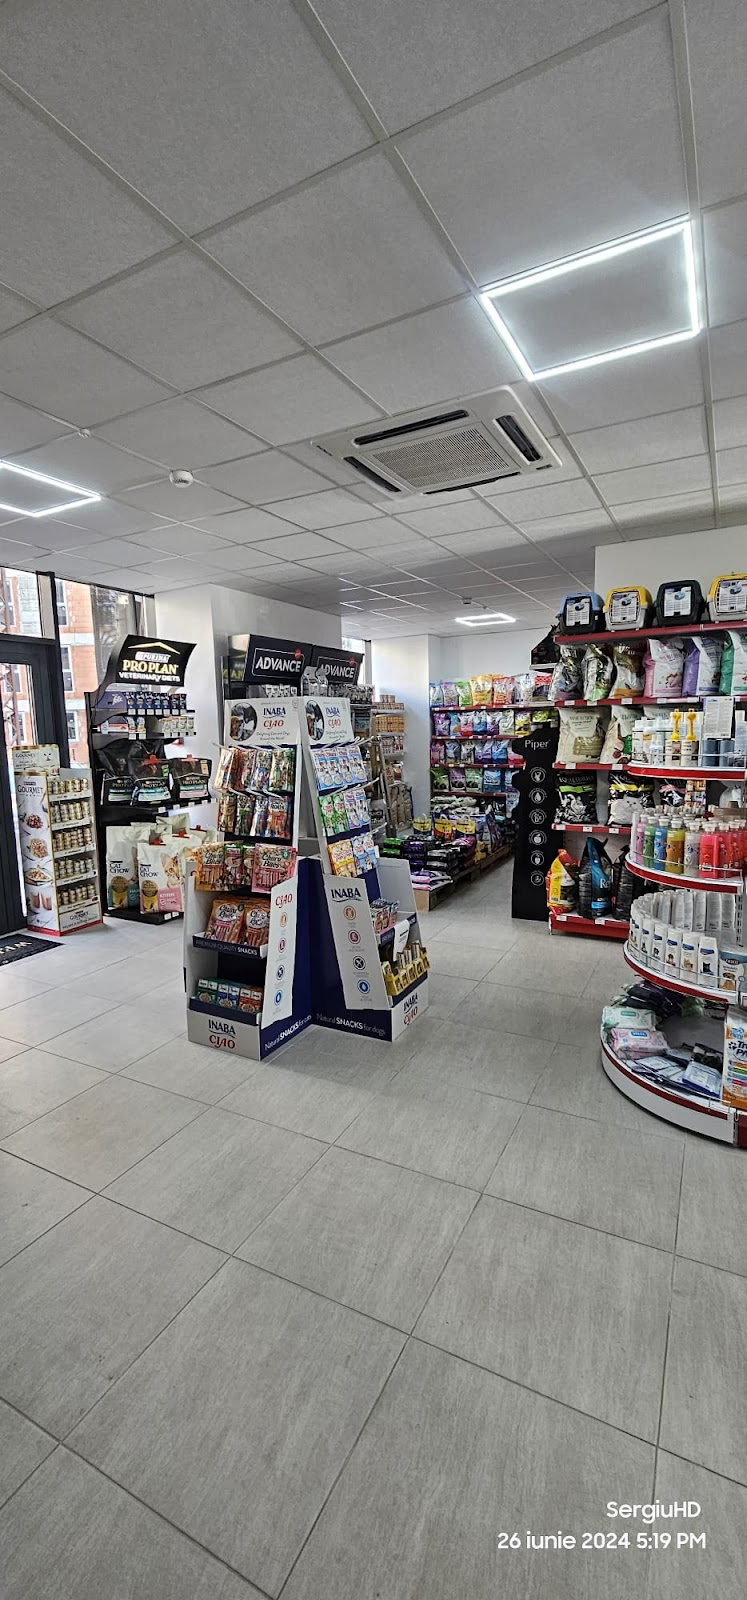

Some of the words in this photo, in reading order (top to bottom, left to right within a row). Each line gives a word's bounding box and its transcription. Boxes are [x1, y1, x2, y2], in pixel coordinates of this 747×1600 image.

[122, 660, 148, 672] PRO
[148, 662, 178, 674] PLAN
[256, 656, 302, 672] ADVANCE
[118, 672, 161, 682] VETERINARY
[263, 707, 286, 716] INABA
[326, 706, 340, 714] INABA
[263, 720, 284, 730] CIAO
[524, 740, 548, 750] Piper
[17, 784, 43, 794] GOURMET
[331, 888, 362, 898] INABA
[276, 894, 292, 908] CIAO
[218, 944, 237, 952] QUALITY
[237, 946, 258, 956] SNACKS
[208, 1020, 236, 1035] INABA
[316, 1014, 336, 1024] Natural
[336, 1017, 363, 1030] SNACKS
[372, 1026, 385, 1036] dogs
[209, 1034, 236, 1049] CIAO
[264, 1034, 280, 1050] Natural
[280, 1021, 299, 1040] SNACKS
